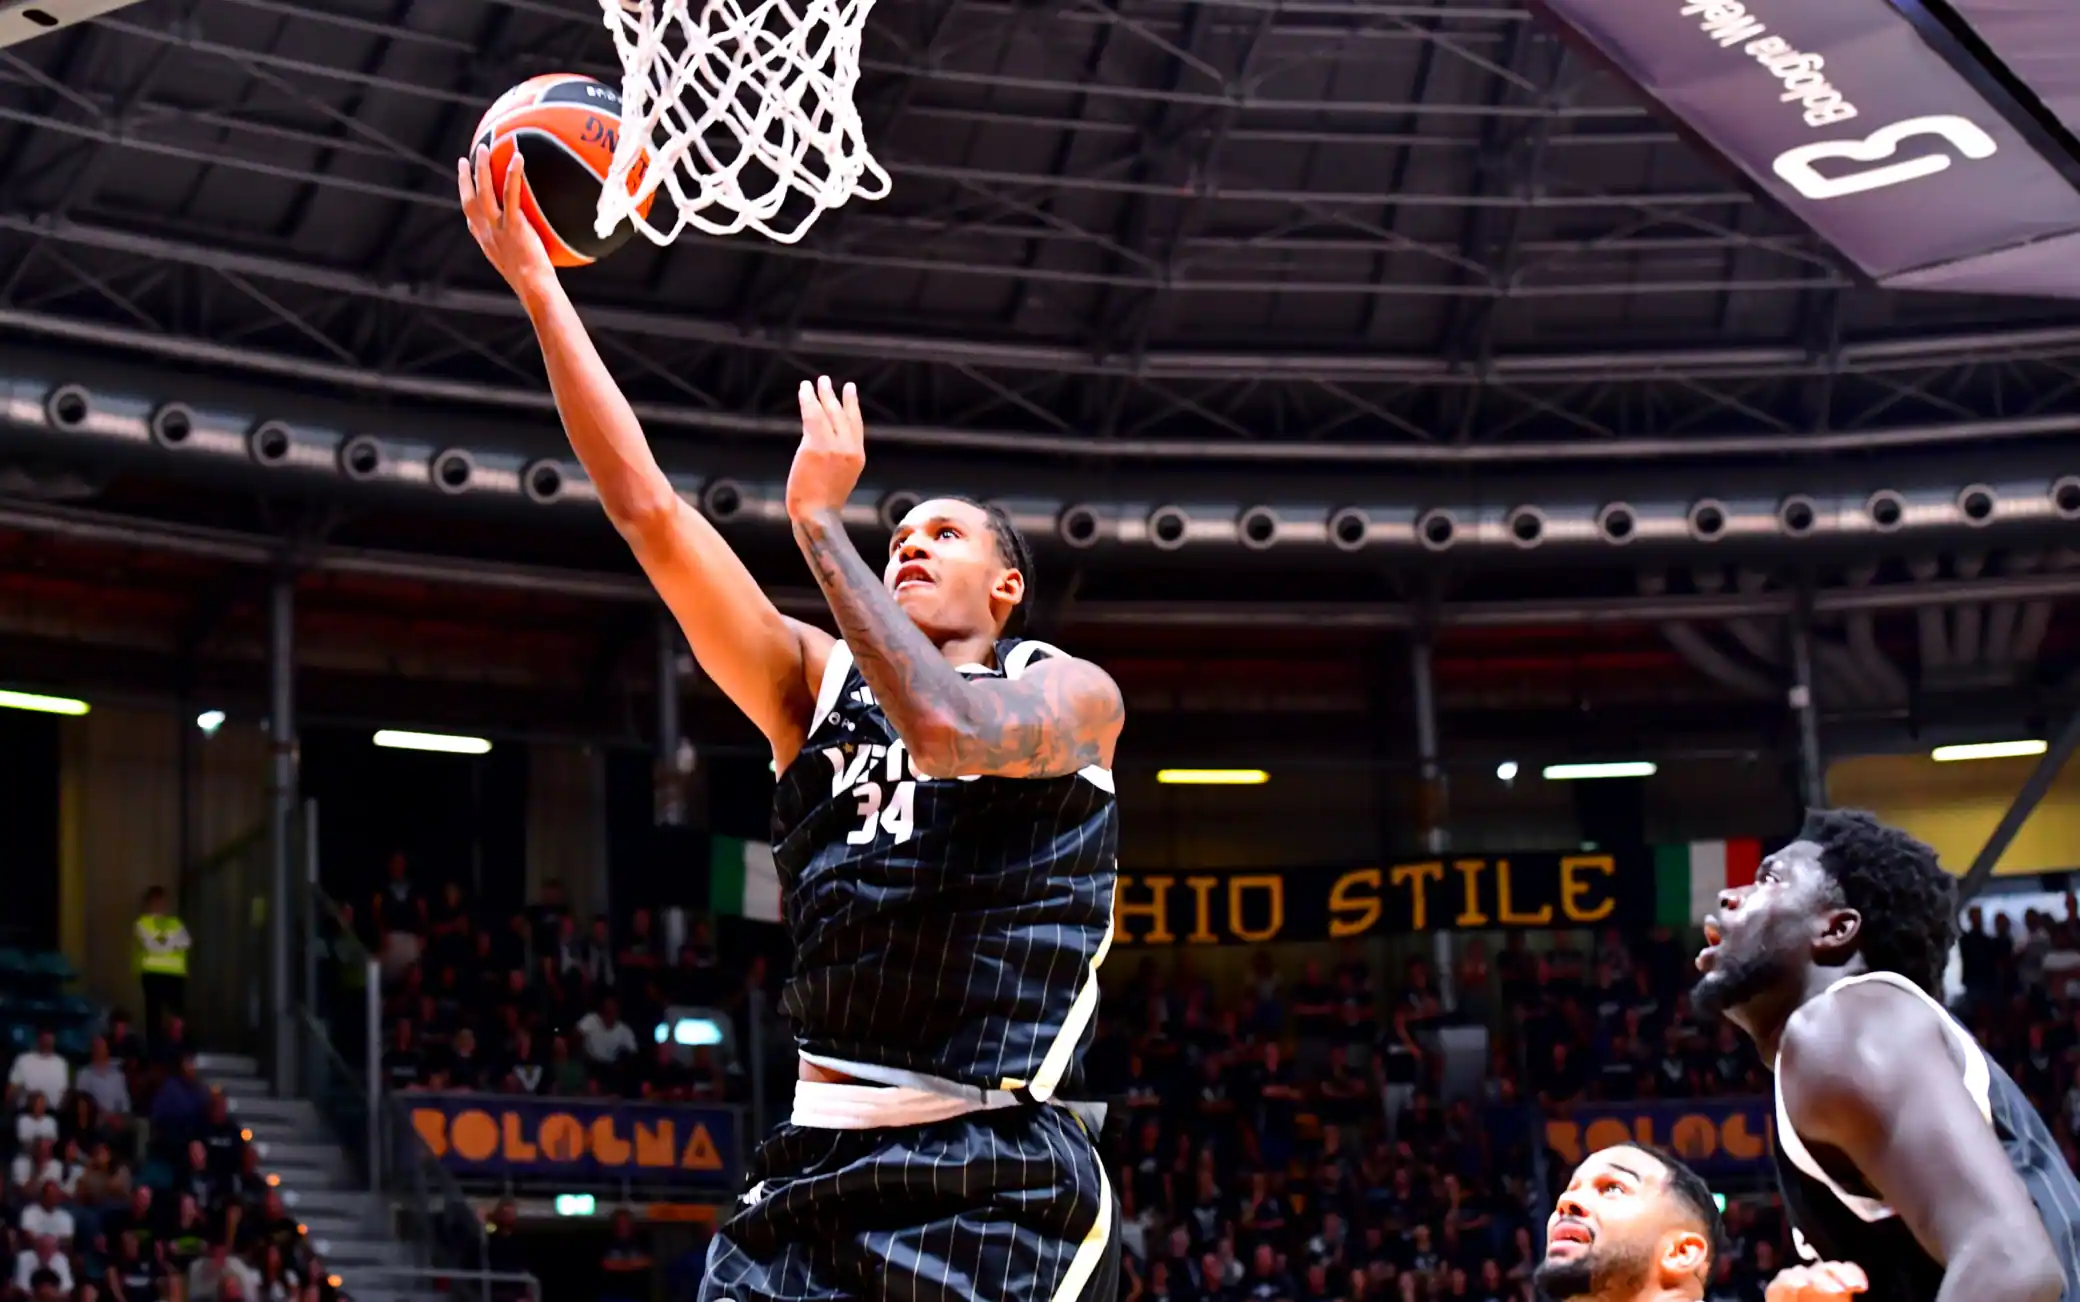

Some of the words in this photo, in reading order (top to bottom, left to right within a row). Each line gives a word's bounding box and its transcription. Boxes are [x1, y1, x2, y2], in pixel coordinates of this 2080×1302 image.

[1680, 0, 1766, 47] Wel
[1745, 35, 1858, 127] Bologna
[846, 780, 916, 845] 34
[1328, 855, 1616, 938] STILE
[411, 1107, 723, 1169] BOLOGNA
